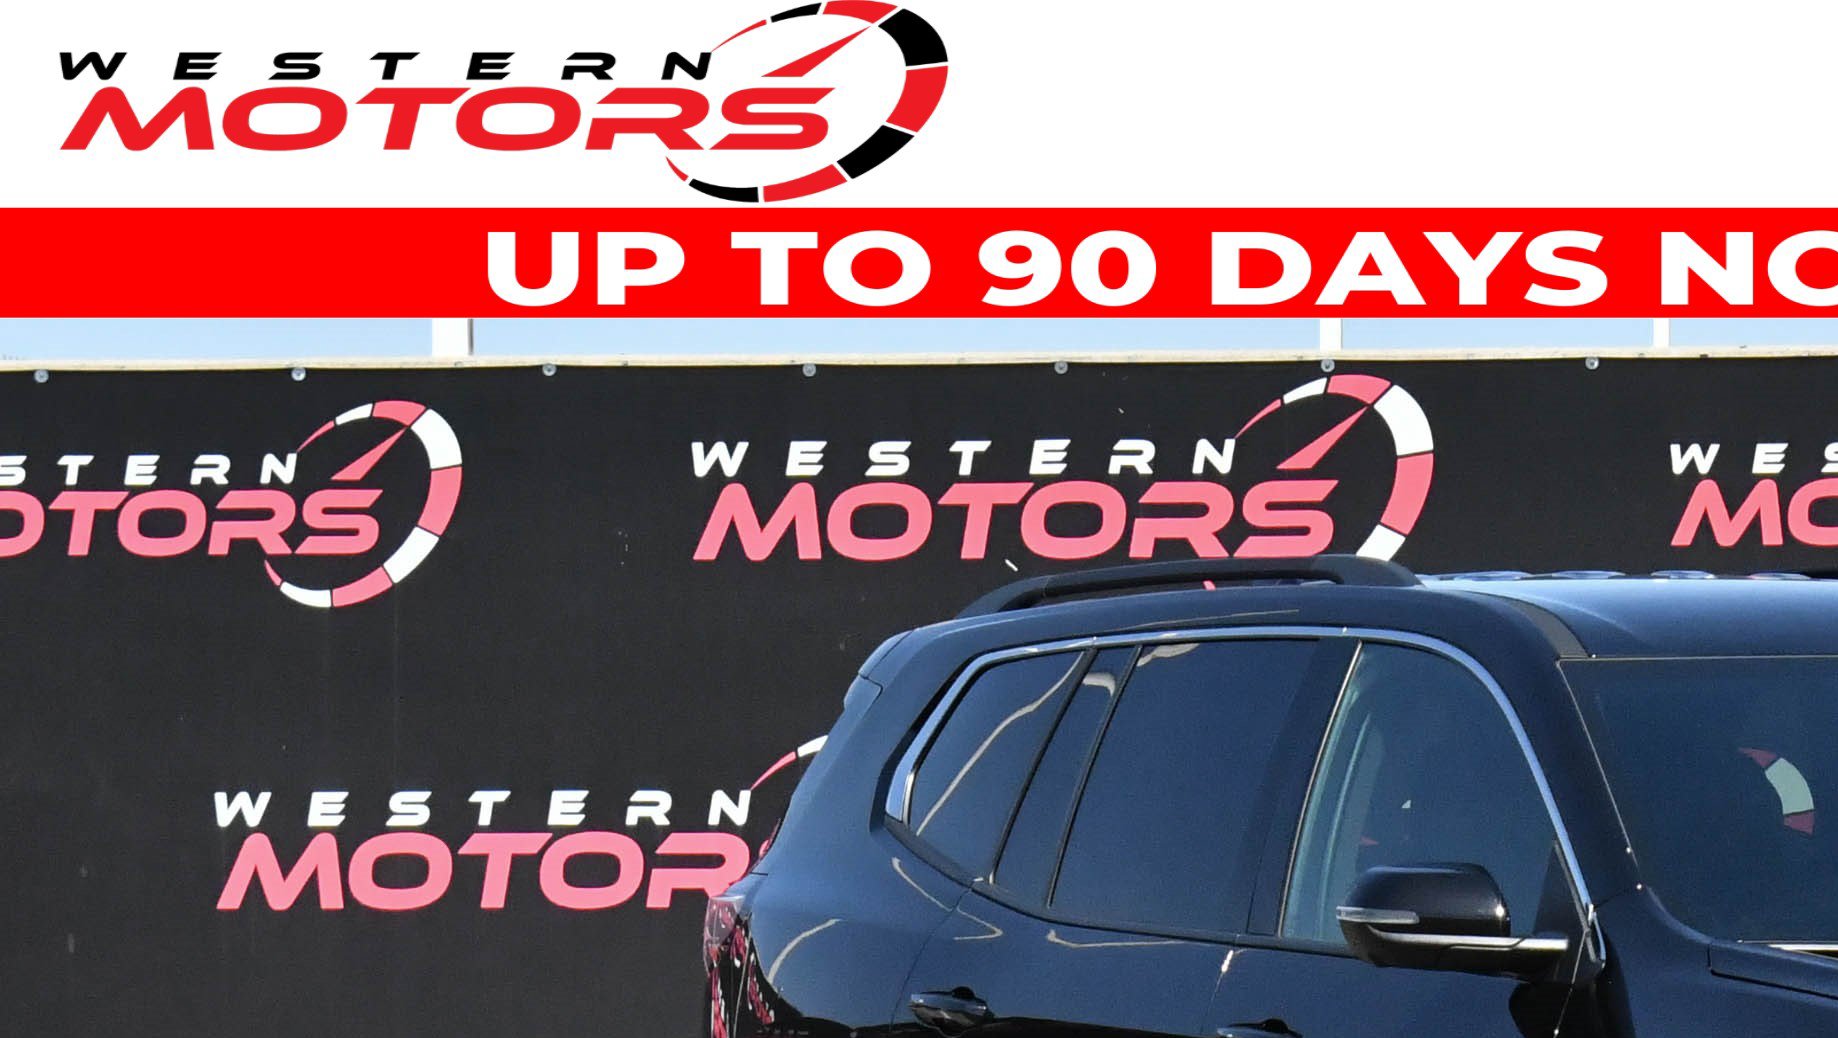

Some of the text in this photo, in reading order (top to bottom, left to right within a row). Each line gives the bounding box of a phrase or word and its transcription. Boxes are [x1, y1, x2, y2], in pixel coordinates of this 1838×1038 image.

[691, 438, 1236, 478] WESTERN
[693, 479, 1339, 561] MOTORS
[213, 789, 752, 828] WESTERN
[216, 831, 768, 910] MOTOR
